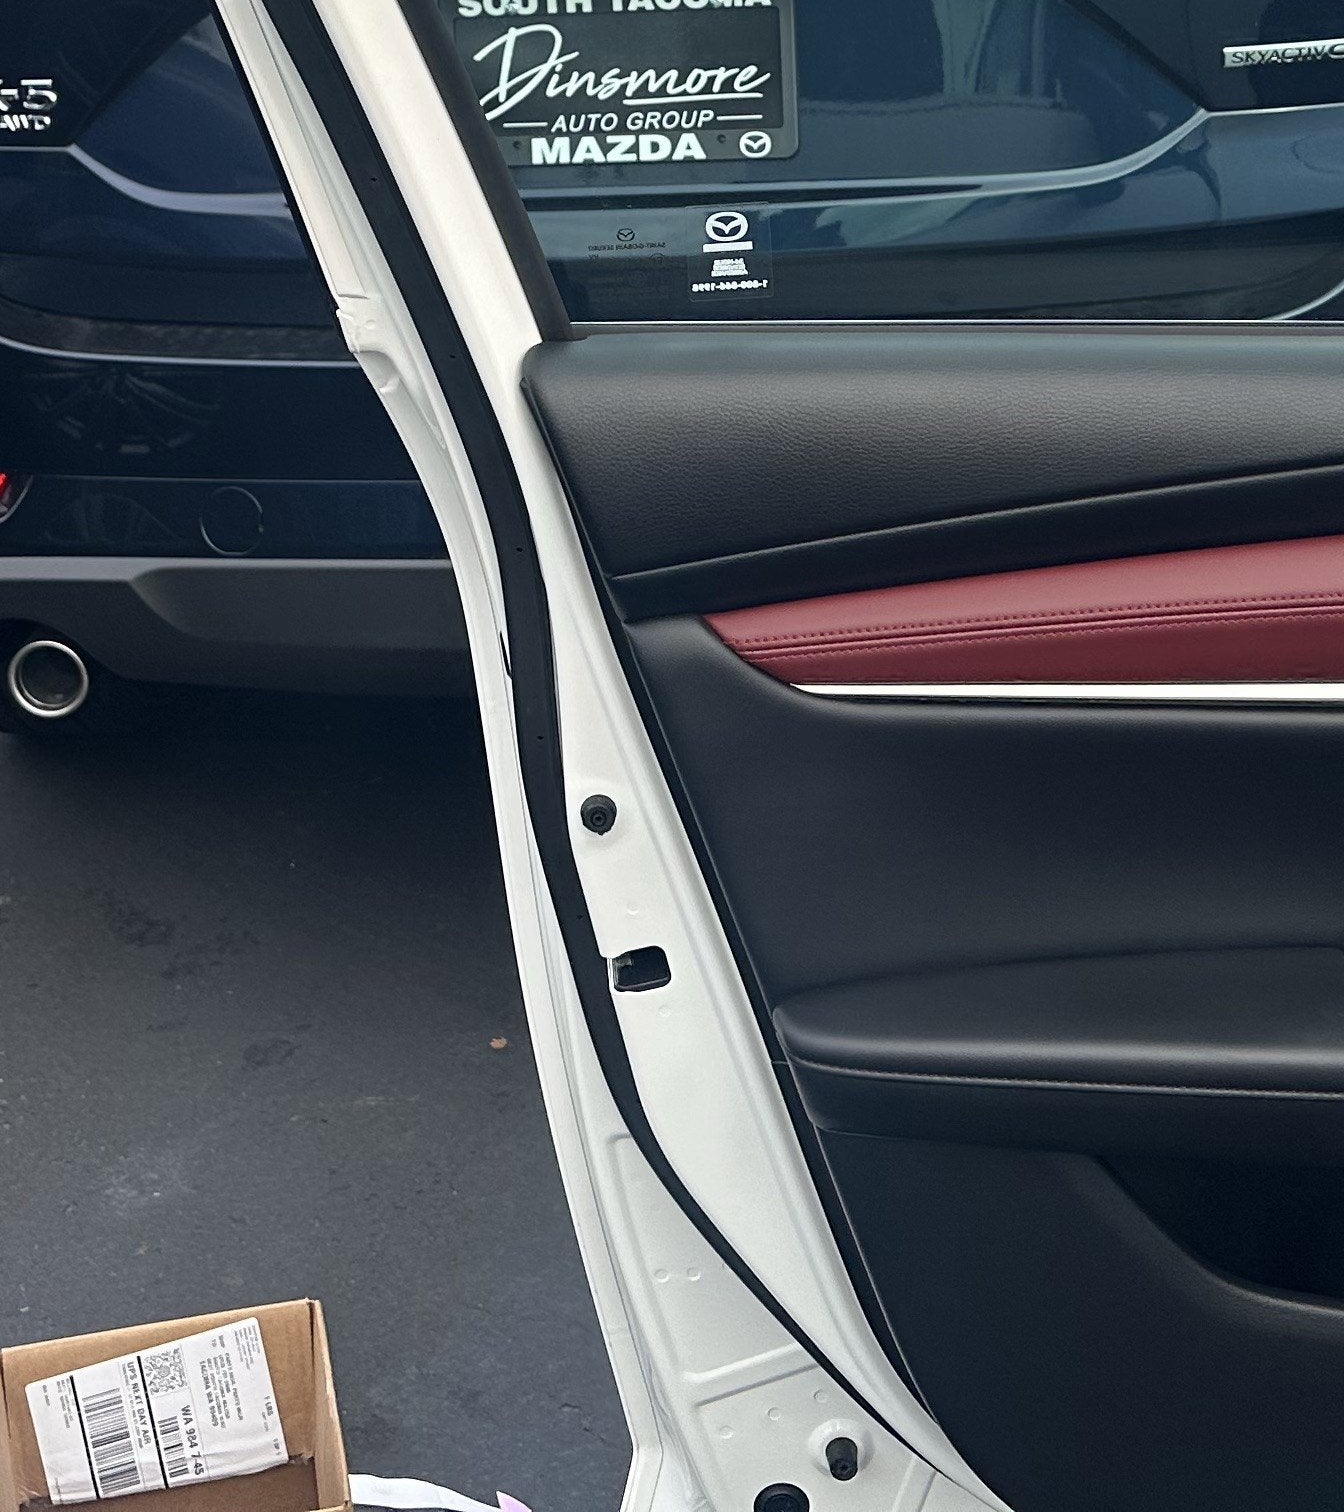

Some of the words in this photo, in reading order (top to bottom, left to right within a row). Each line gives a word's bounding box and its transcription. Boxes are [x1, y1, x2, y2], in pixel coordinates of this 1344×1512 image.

[473, 23, 771, 121] Dinsmore
[0, 114, 51, 131] AWD
[551, 111, 619, 133] AUTO
[626, 109, 715, 131] GROUP
[531, 132, 707, 165] MAZDA
[127, 1361, 138, 1380] UPS
[131, 1382, 143, 1405] NEXT
[136, 1407, 148, 1427] DAY
[180, 1405, 194, 1425] WA
[142, 1429, 152, 1445] AIR
